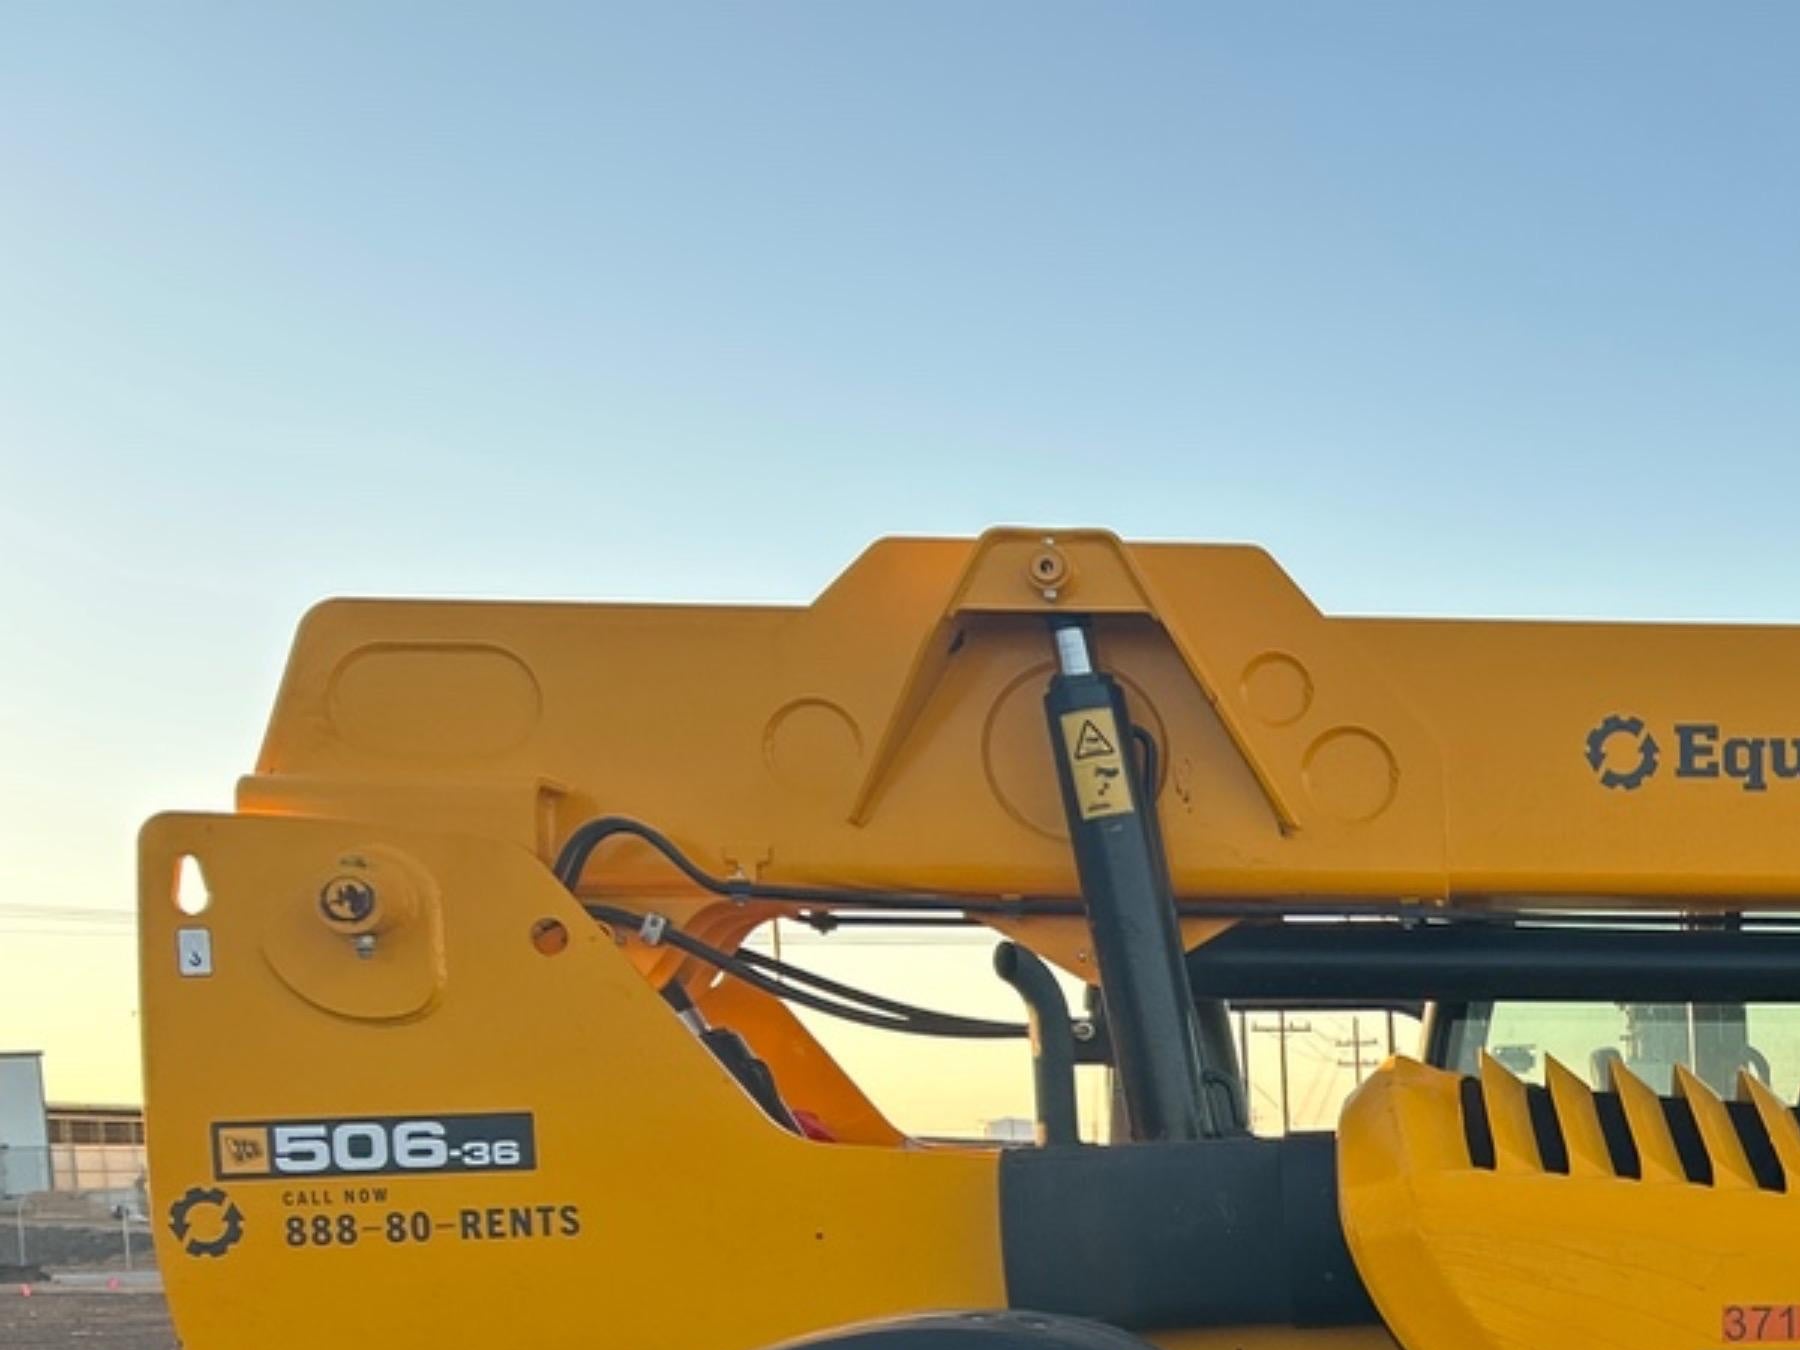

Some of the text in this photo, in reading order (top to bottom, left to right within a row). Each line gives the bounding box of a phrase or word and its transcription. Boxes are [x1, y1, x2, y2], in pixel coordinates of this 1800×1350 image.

[274, 1121, 521, 1173] 506-36
[282, 1188, 388, 1206] CALL NOW
[286, 1205, 581, 1247] 888-80-RENTS
